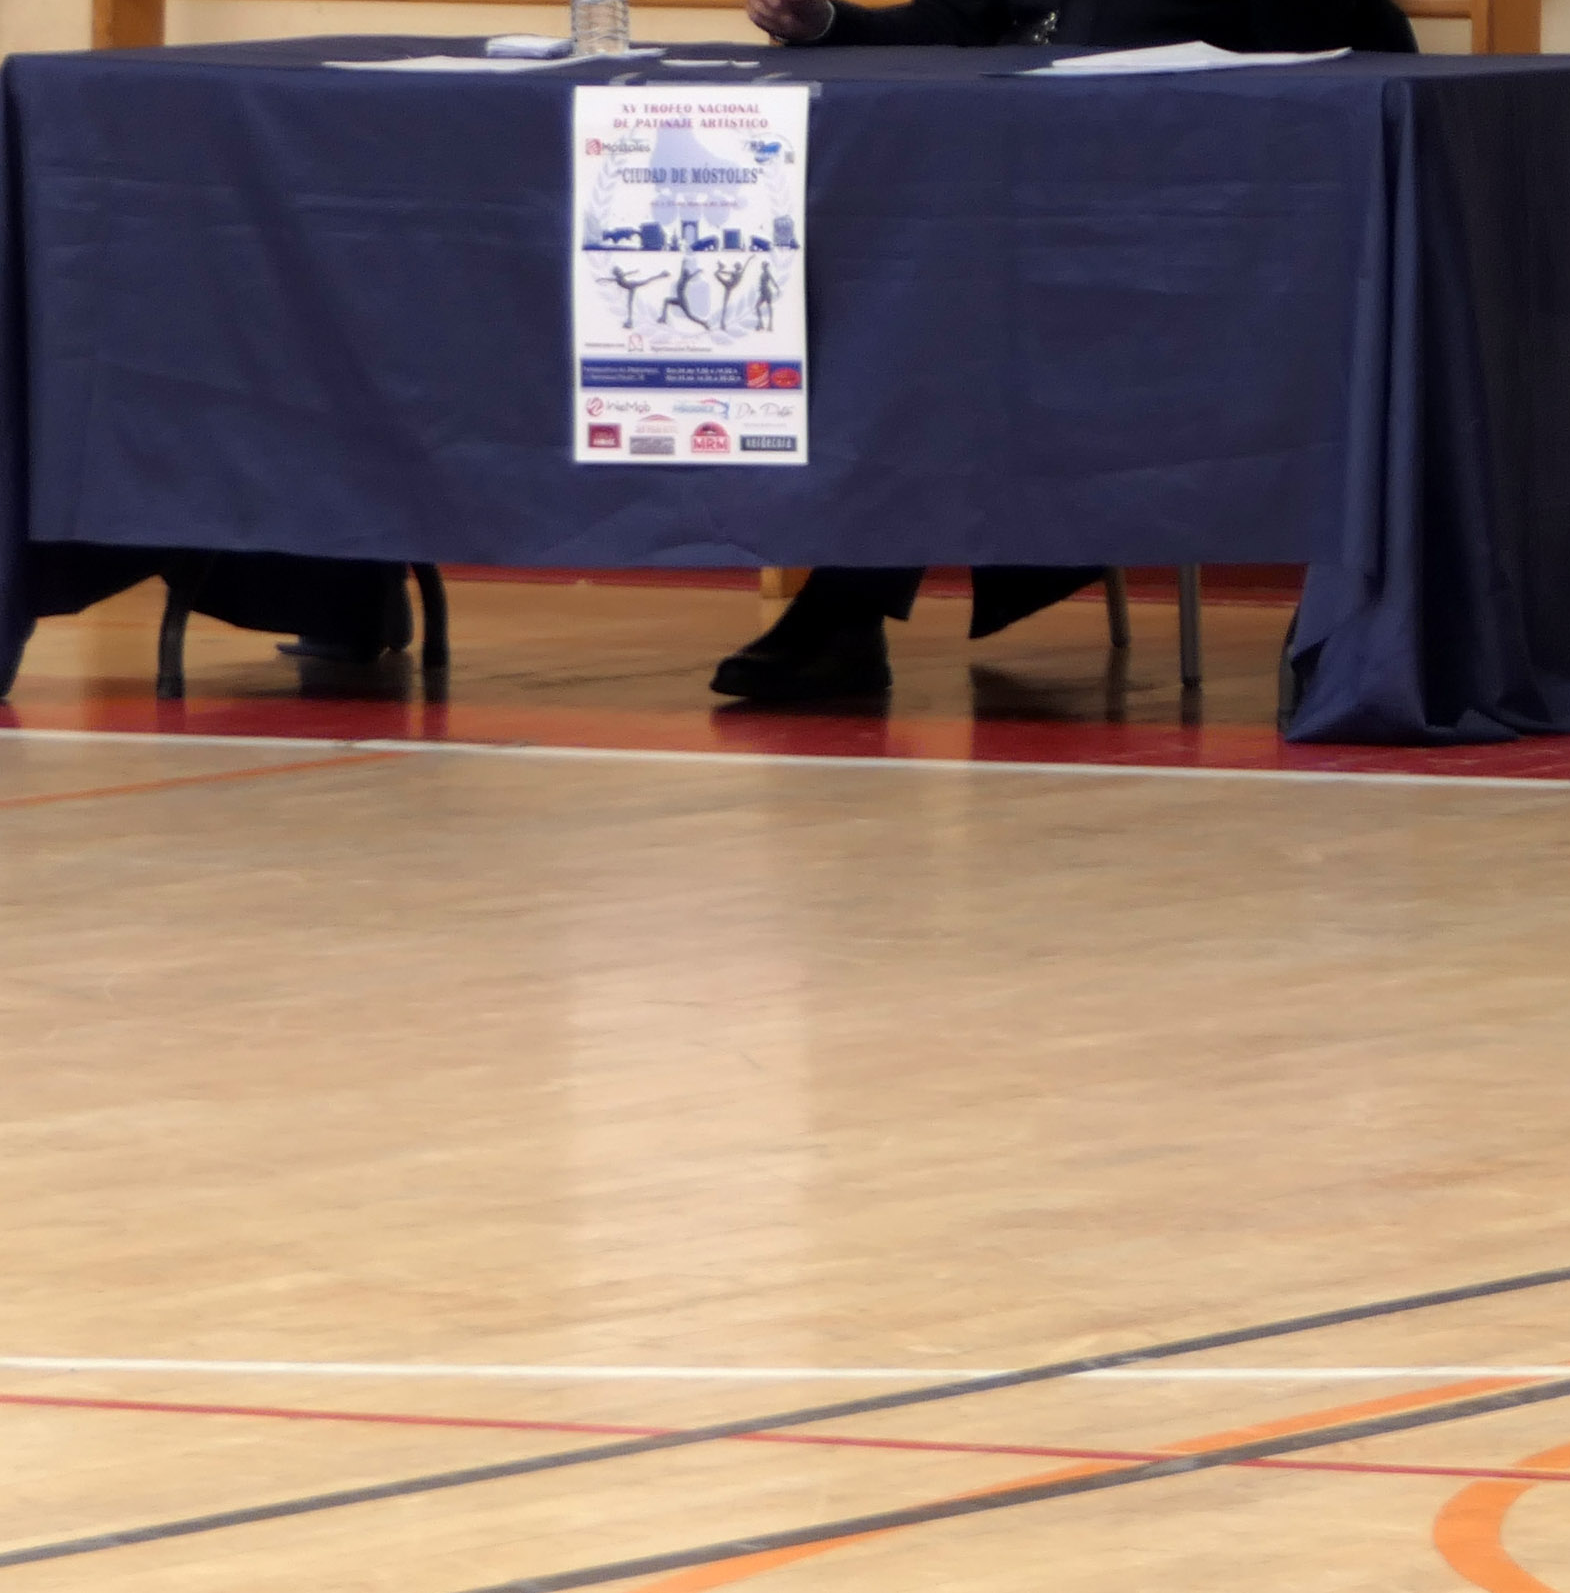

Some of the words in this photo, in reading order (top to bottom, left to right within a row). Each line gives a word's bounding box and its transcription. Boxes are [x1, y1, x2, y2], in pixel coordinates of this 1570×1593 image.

[644, 103, 692, 114] TROFEO
[698, 103, 761, 114] NACIONAL
[613, 118, 628, 128] DE
[634, 118, 693, 128] PATINAJE
[671, 168, 689, 184] DE
[693, 437, 728, 450] MRM
